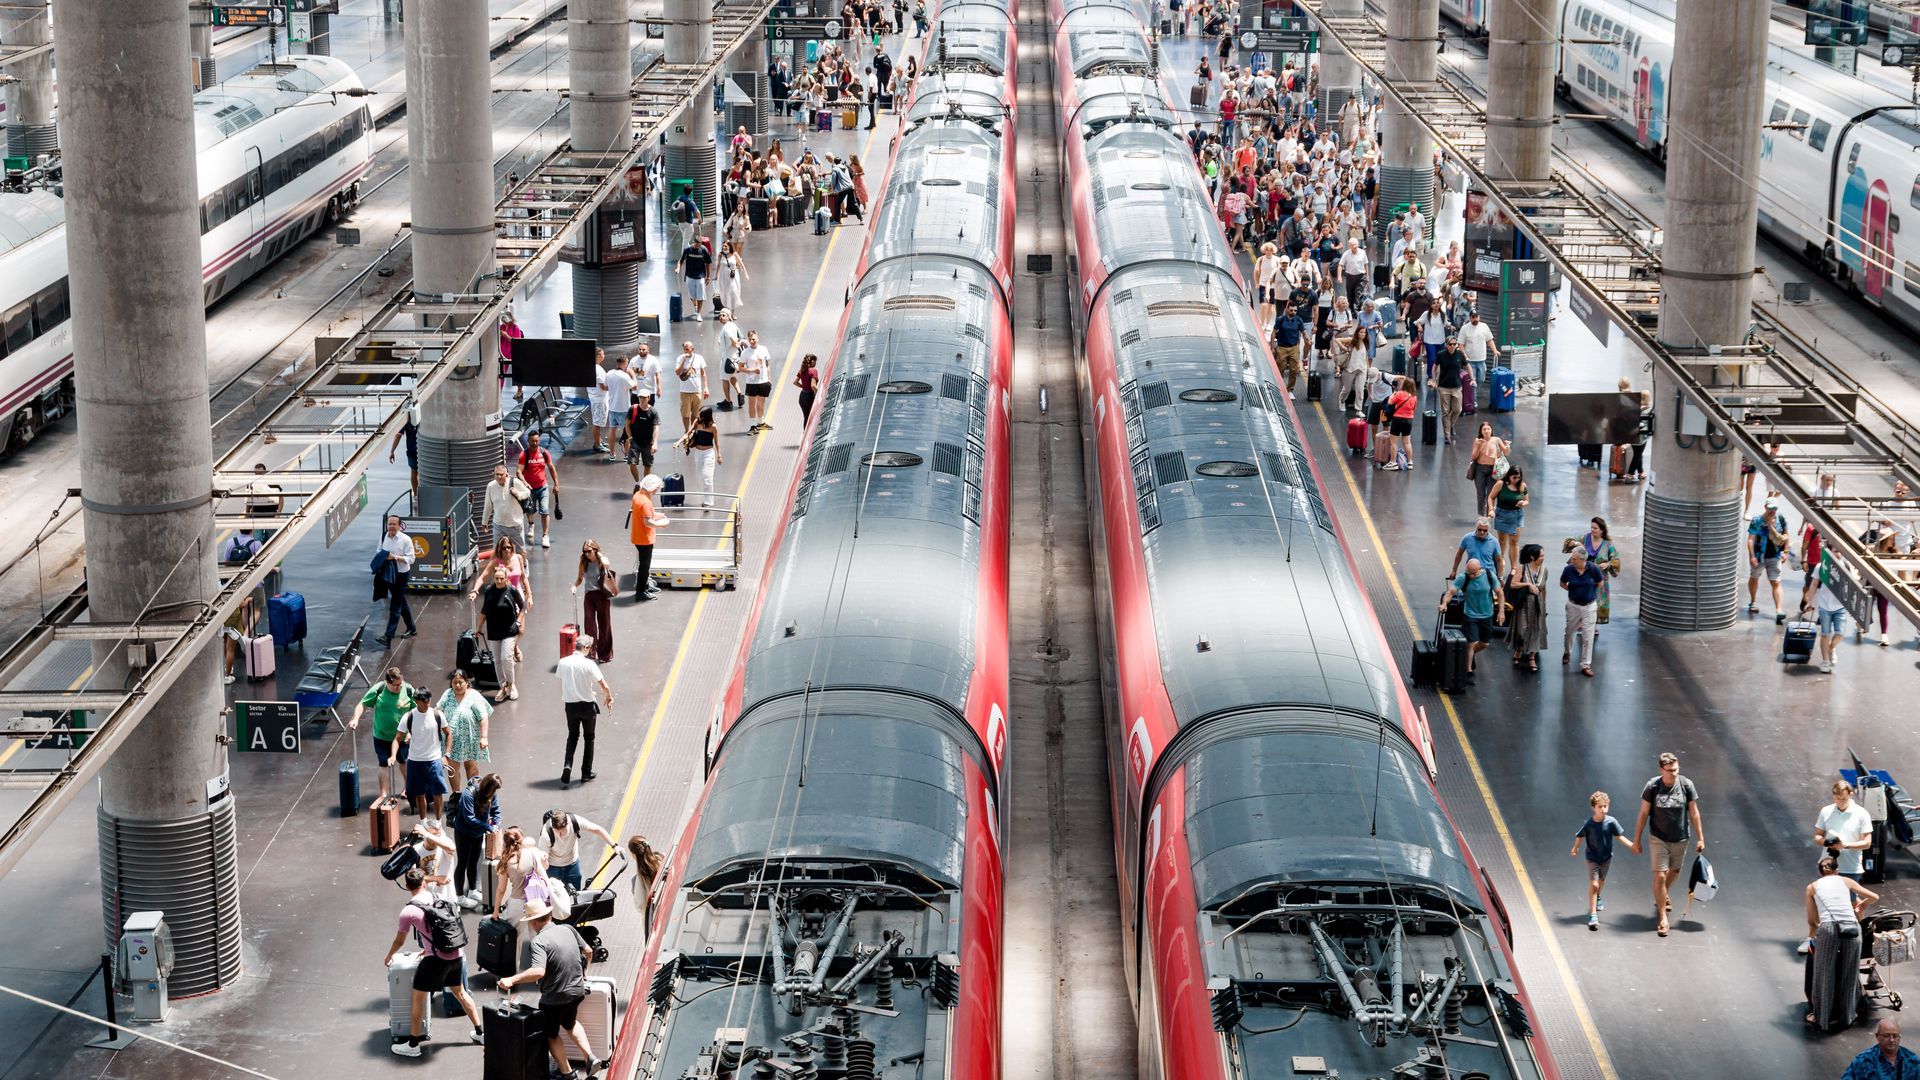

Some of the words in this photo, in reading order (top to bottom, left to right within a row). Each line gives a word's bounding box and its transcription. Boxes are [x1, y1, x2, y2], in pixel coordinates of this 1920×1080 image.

[220, 14, 227, 24] 4
[775, 27, 783, 38] 6
[1302, 40, 1310, 51] 7
[57, 723, 74, 746] A
[251, 726, 268, 749] A
[281, 727, 297, 750] 6
